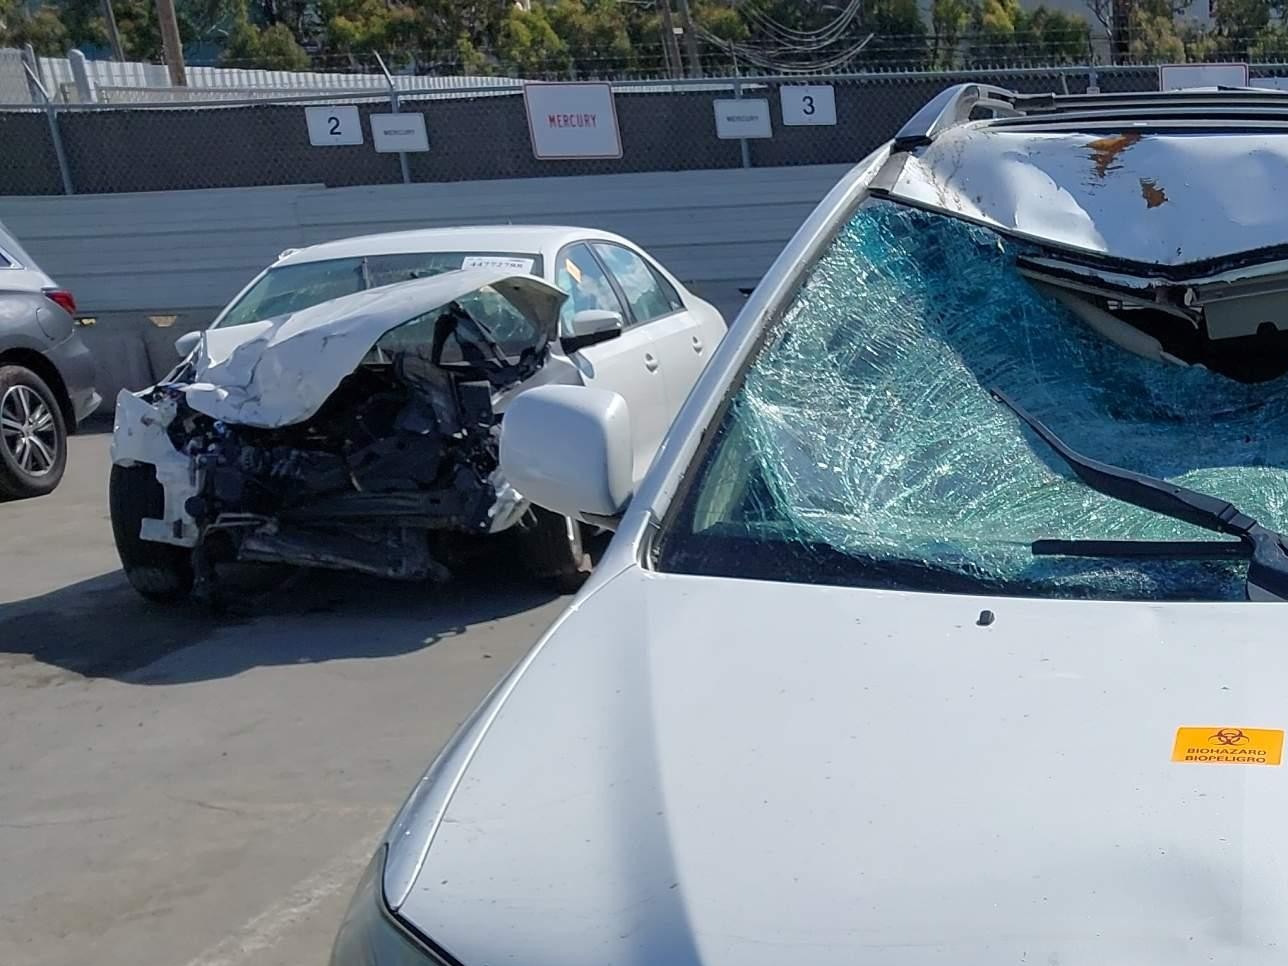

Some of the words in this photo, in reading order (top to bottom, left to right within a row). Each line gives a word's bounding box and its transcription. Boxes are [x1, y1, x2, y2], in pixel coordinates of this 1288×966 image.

[802, 96, 815, 115] 3
[327, 116, 342, 135] 2
[548, 113, 597, 128] MERCURY
[1185, 755, 1266, 763] BIOPELIGRO
[1187, 747, 1267, 756] BIOHAZARD
